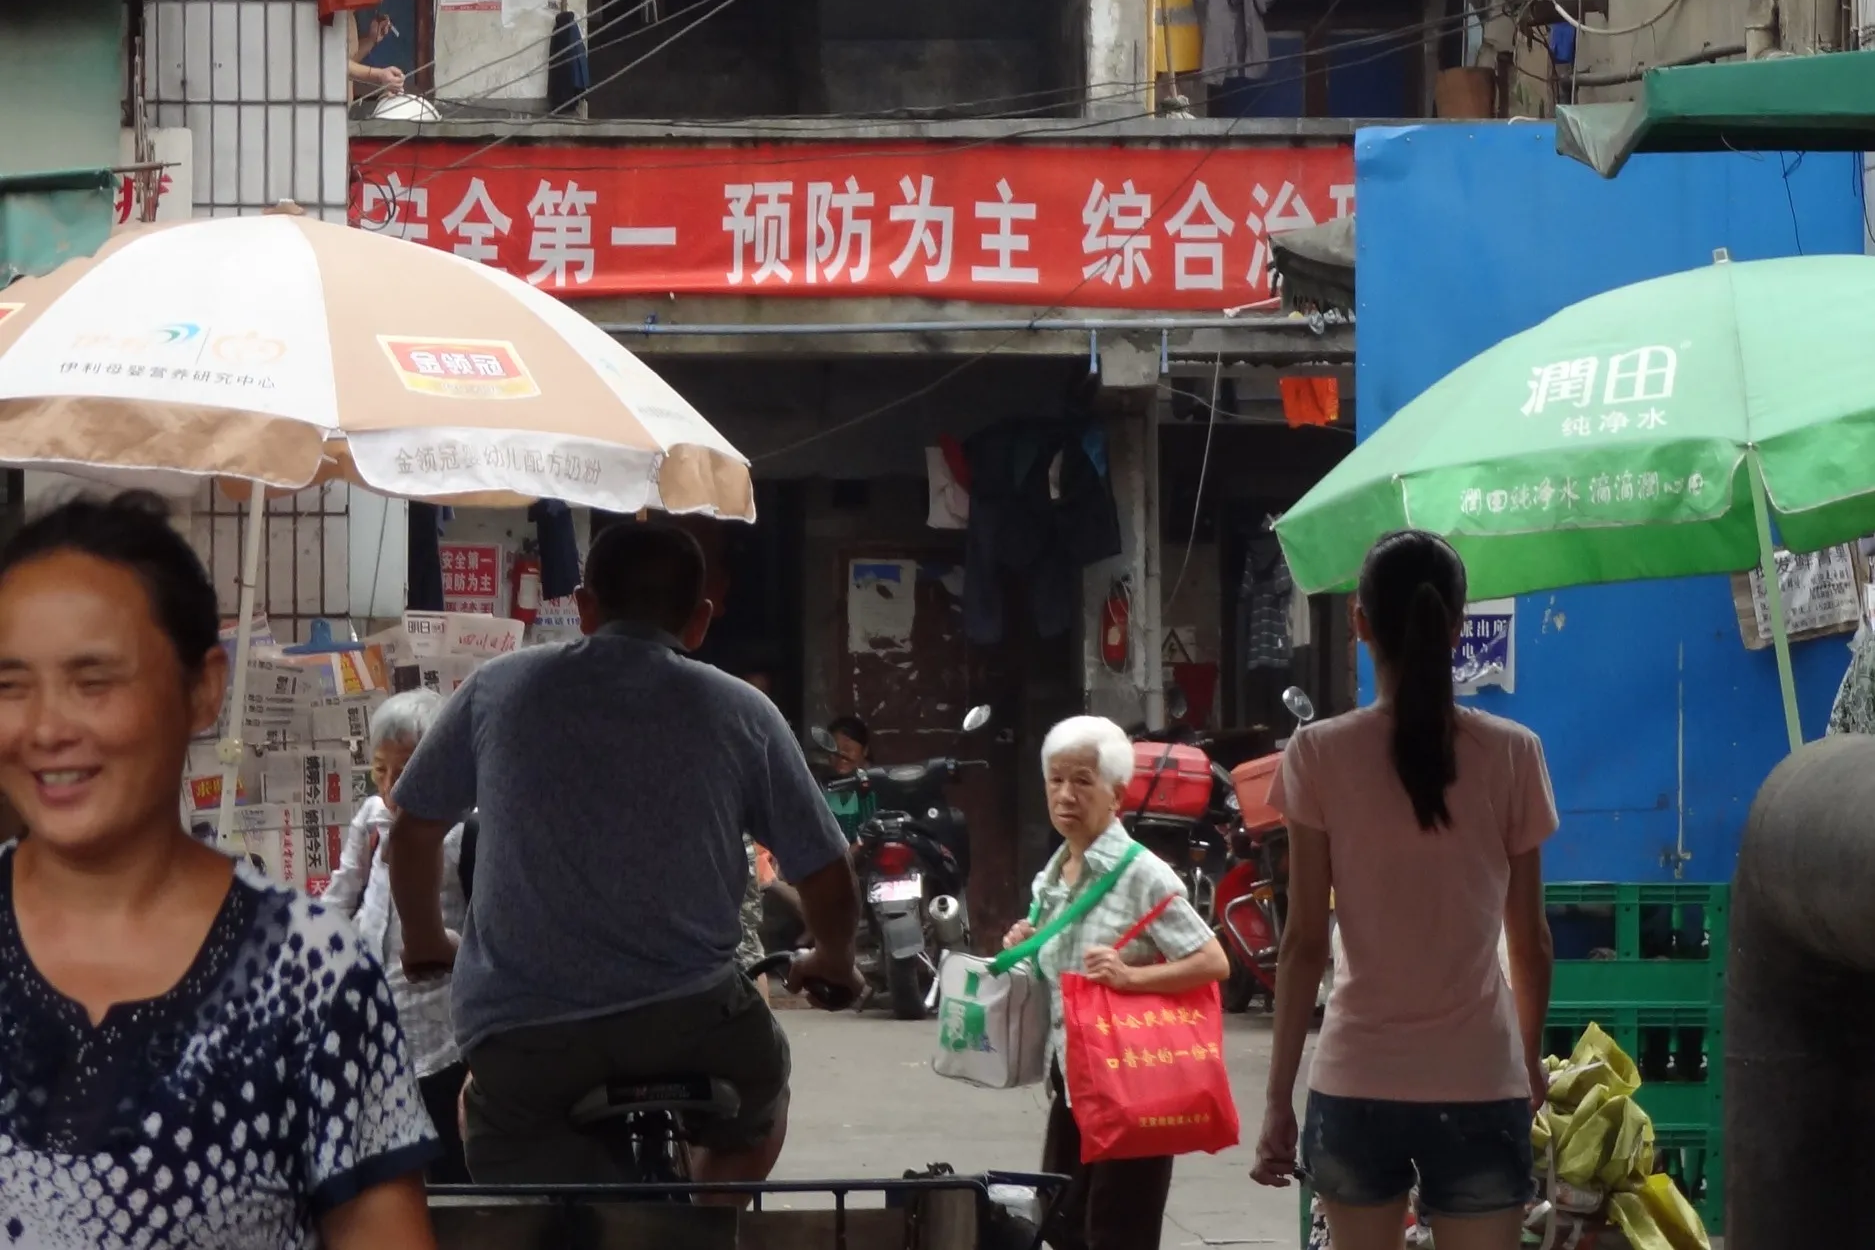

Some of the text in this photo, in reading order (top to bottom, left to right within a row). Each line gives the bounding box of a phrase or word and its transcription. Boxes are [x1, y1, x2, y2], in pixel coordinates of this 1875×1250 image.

[722, 174, 1040, 286] 预防为主
[1561, 406, 1668, 437] 纯净水
[441, 551, 493, 571] 安全第一
